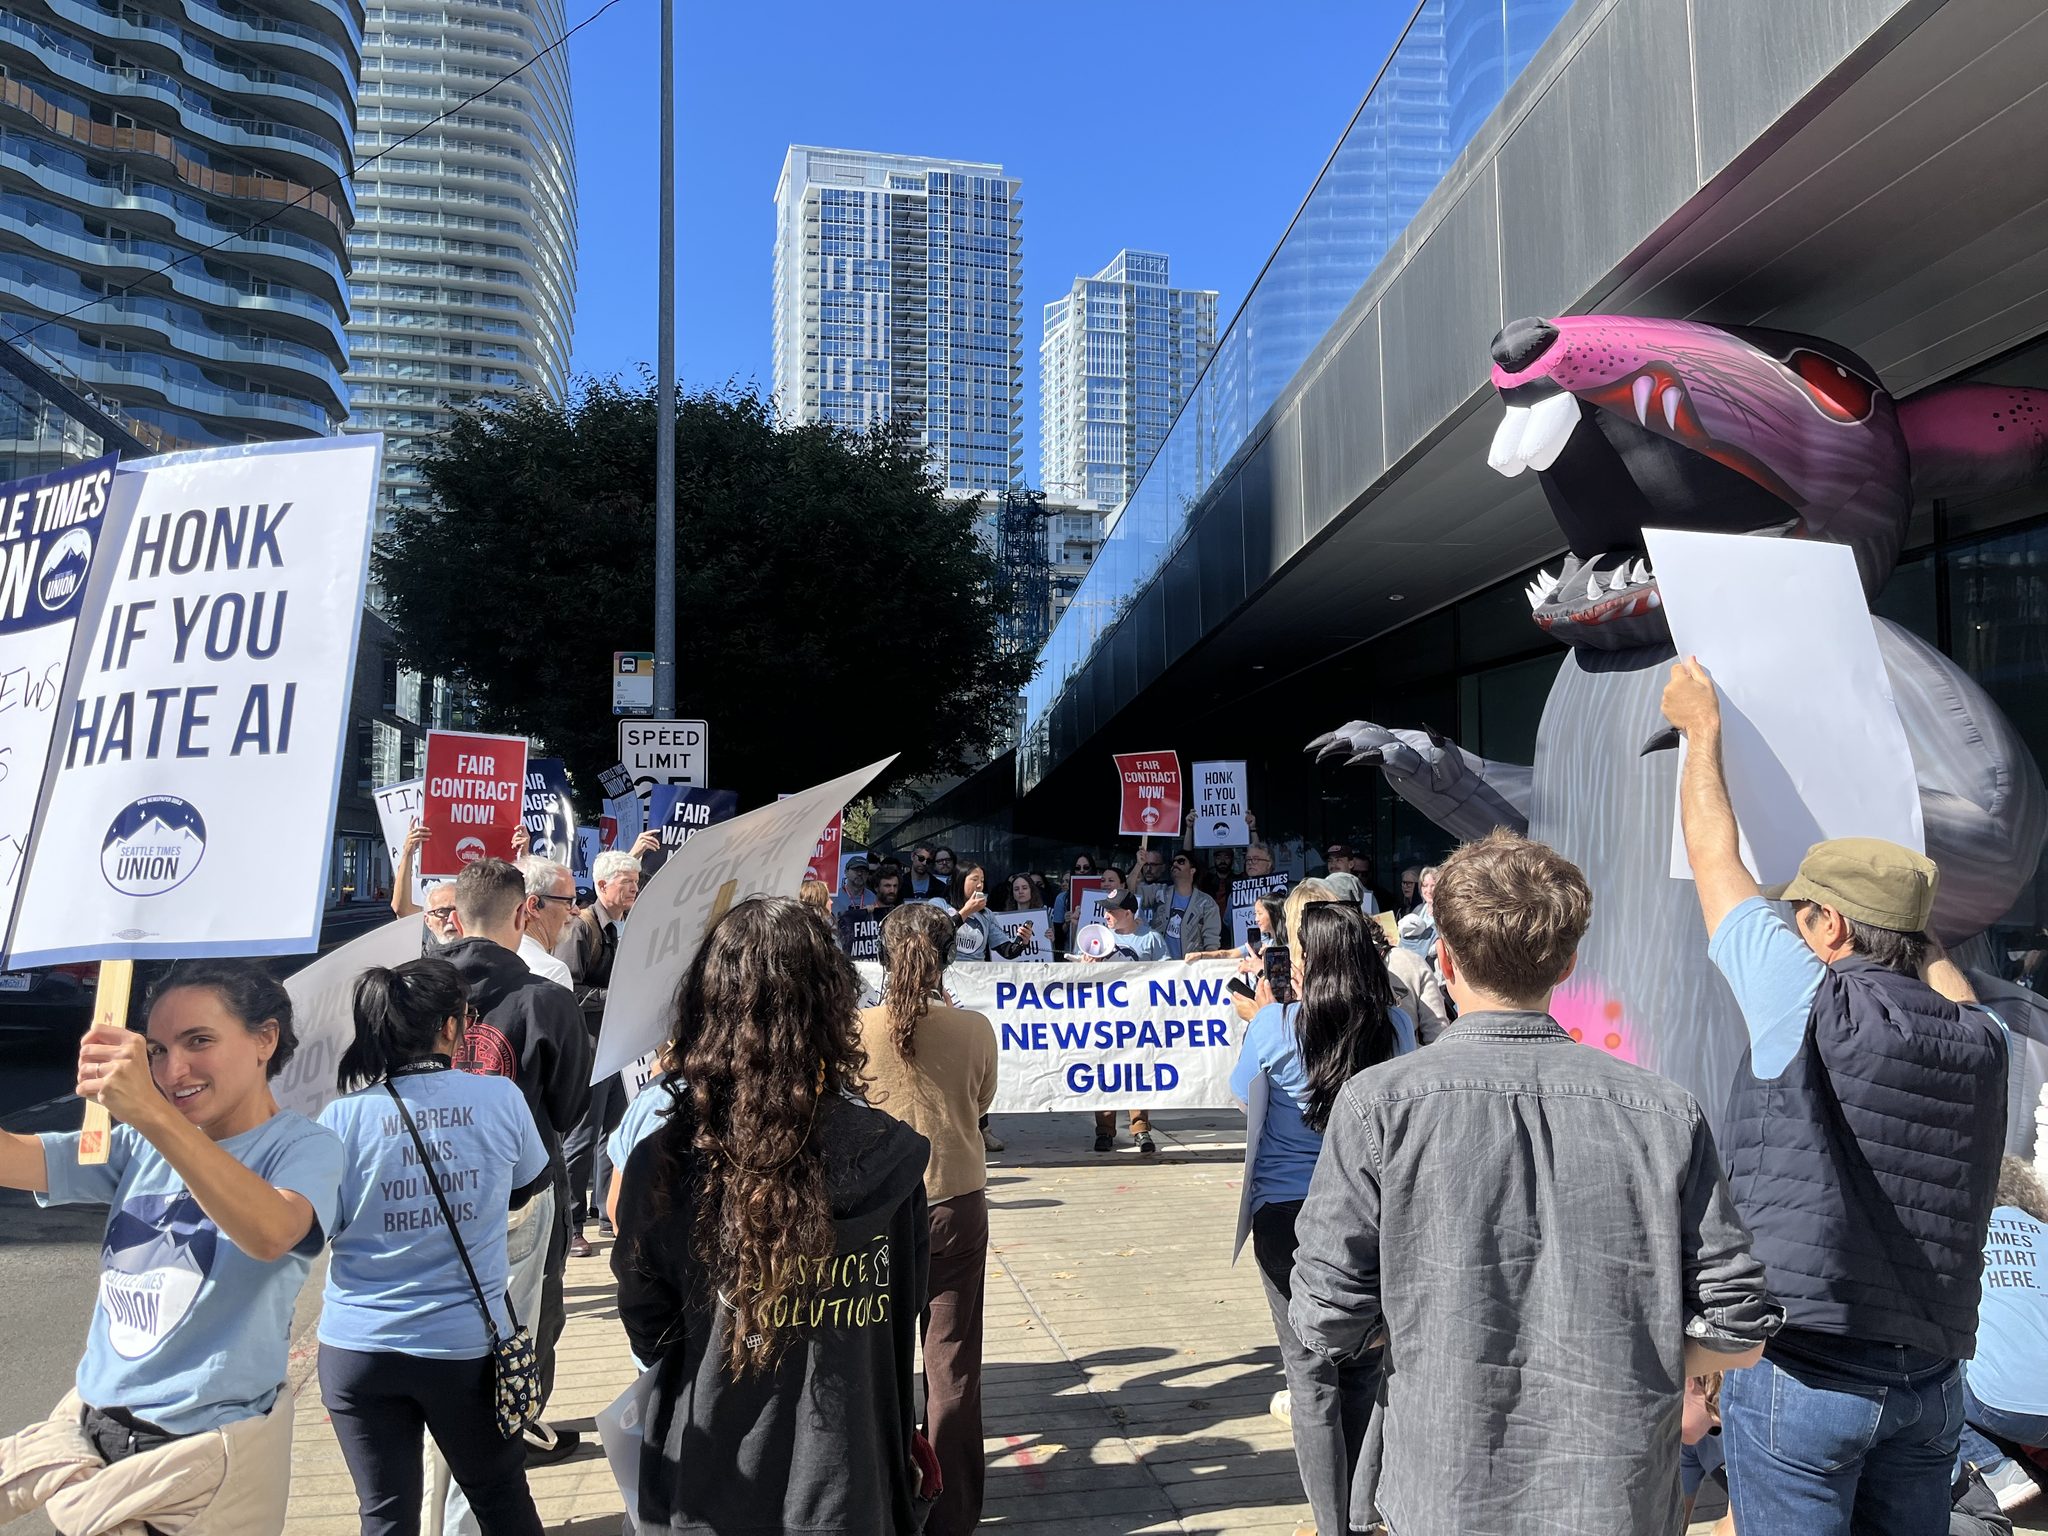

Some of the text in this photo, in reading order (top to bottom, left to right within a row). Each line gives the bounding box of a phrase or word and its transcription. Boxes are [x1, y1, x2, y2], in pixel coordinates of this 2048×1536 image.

[32, 470, 111, 535] TIMES
[128, 502, 294, 581] HONK
[45, 574, 77, 601] UNION
[100, 590, 288, 672] IF YOU
[65, 682, 297, 770] HATE AI
[628, 730, 699, 746] SPEED
[457, 754, 495, 776] FAIR
[635, 753, 691, 769] LIMIT
[1136, 760, 1160, 770] FAIR
[524, 773, 546, 790] AIR
[603, 776, 626, 798] UNION
[1124, 771, 1177, 784] CONTRACT
[1205, 771, 1234, 785] HONK
[430, 778, 518, 802] CONTRACT
[1138, 785, 1165, 799] NOW!
[1204, 787, 1236, 801] IF YOU
[524, 793, 557, 811] AGES
[1201, 803, 1240, 817] HATE AI
[450, 803, 495, 825] NOW!
[674, 802, 710, 825] FAIR
[121, 847, 181, 857] SEATTLE TIMES
[116, 857, 179, 880] UNION
[1232, 873, 1288, 891] SEATTLE TIMES
[854, 920, 878, 938] FAIR
[997, 979, 1231, 1009] PACIFIC N.W.
[1002, 1019, 1230, 1050] NEWSPAPER
[1066, 1063, 1179, 1094] GUILD
[415, 1106, 475, 1132] BREAK
[380, 1169, 480, 1202] YOU WON'T
[384, 1206, 446, 1233] BREAK
[1988, 1218, 2042, 1234] ETTER
[1988, 1231, 2033, 1248] IMES
[1983, 1250, 2037, 1267] START
[1986, 1271, 2041, 1289] HERE.
[106, 1284, 160, 1336] UNION
